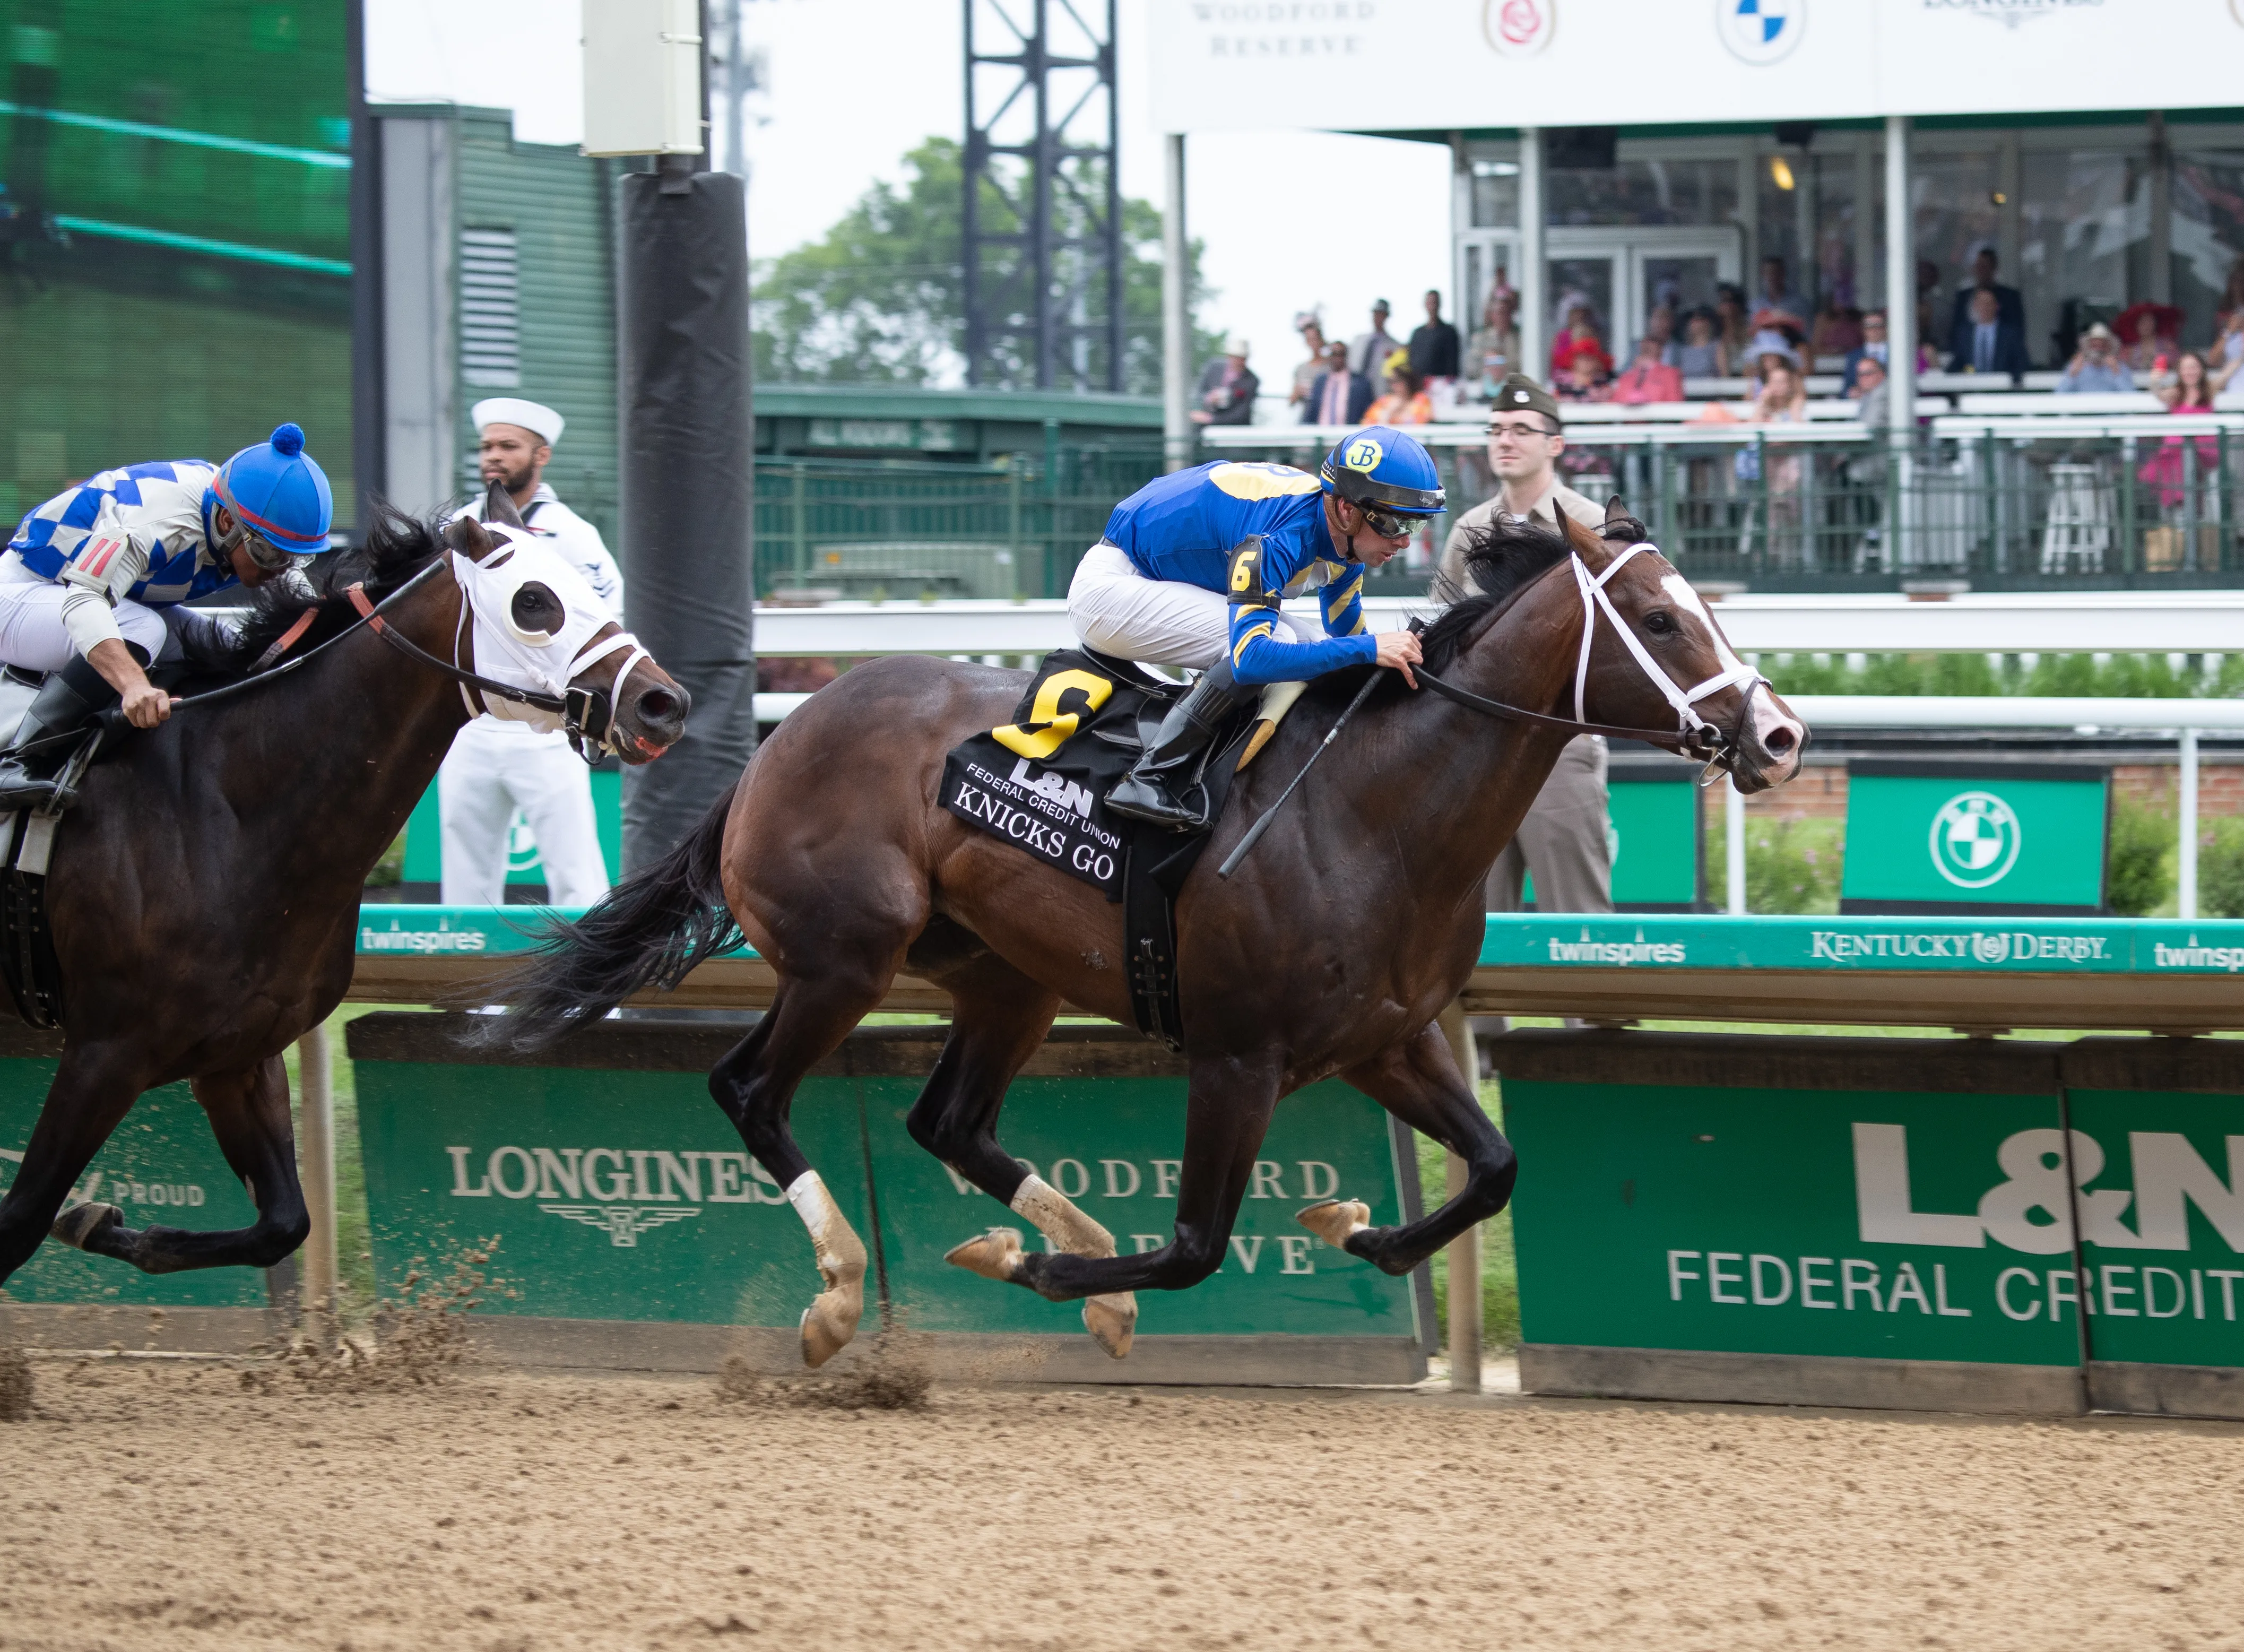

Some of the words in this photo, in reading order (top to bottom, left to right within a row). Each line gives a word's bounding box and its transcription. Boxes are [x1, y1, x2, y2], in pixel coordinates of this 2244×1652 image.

[1231, 551, 1257, 591] 6
[966, 763, 1025, 801] FEDERAL
[1029, 795, 1079, 826] CREDIT
[1081, 820, 1120, 849] UNION
[1009, 758, 1093, 818] L&N
[955, 782, 1066, 857] KNICKS
[1073, 845, 1113, 879] GO
[361, 919, 485, 954] twinspires
[1549, 925, 1686, 966] twinspires
[1810, 932, 1971, 962] KENTUCKY
[2011, 932, 2107, 963] DERBY
[112, 1182, 205, 1207] PROUD
[446, 1146, 789, 1205] LONGINES
[1851, 1122, 2244, 1255] L&N
[1667, 1250, 1972, 1318] FEDERAL
[1995, 1265, 2244, 1322] CREDIT
